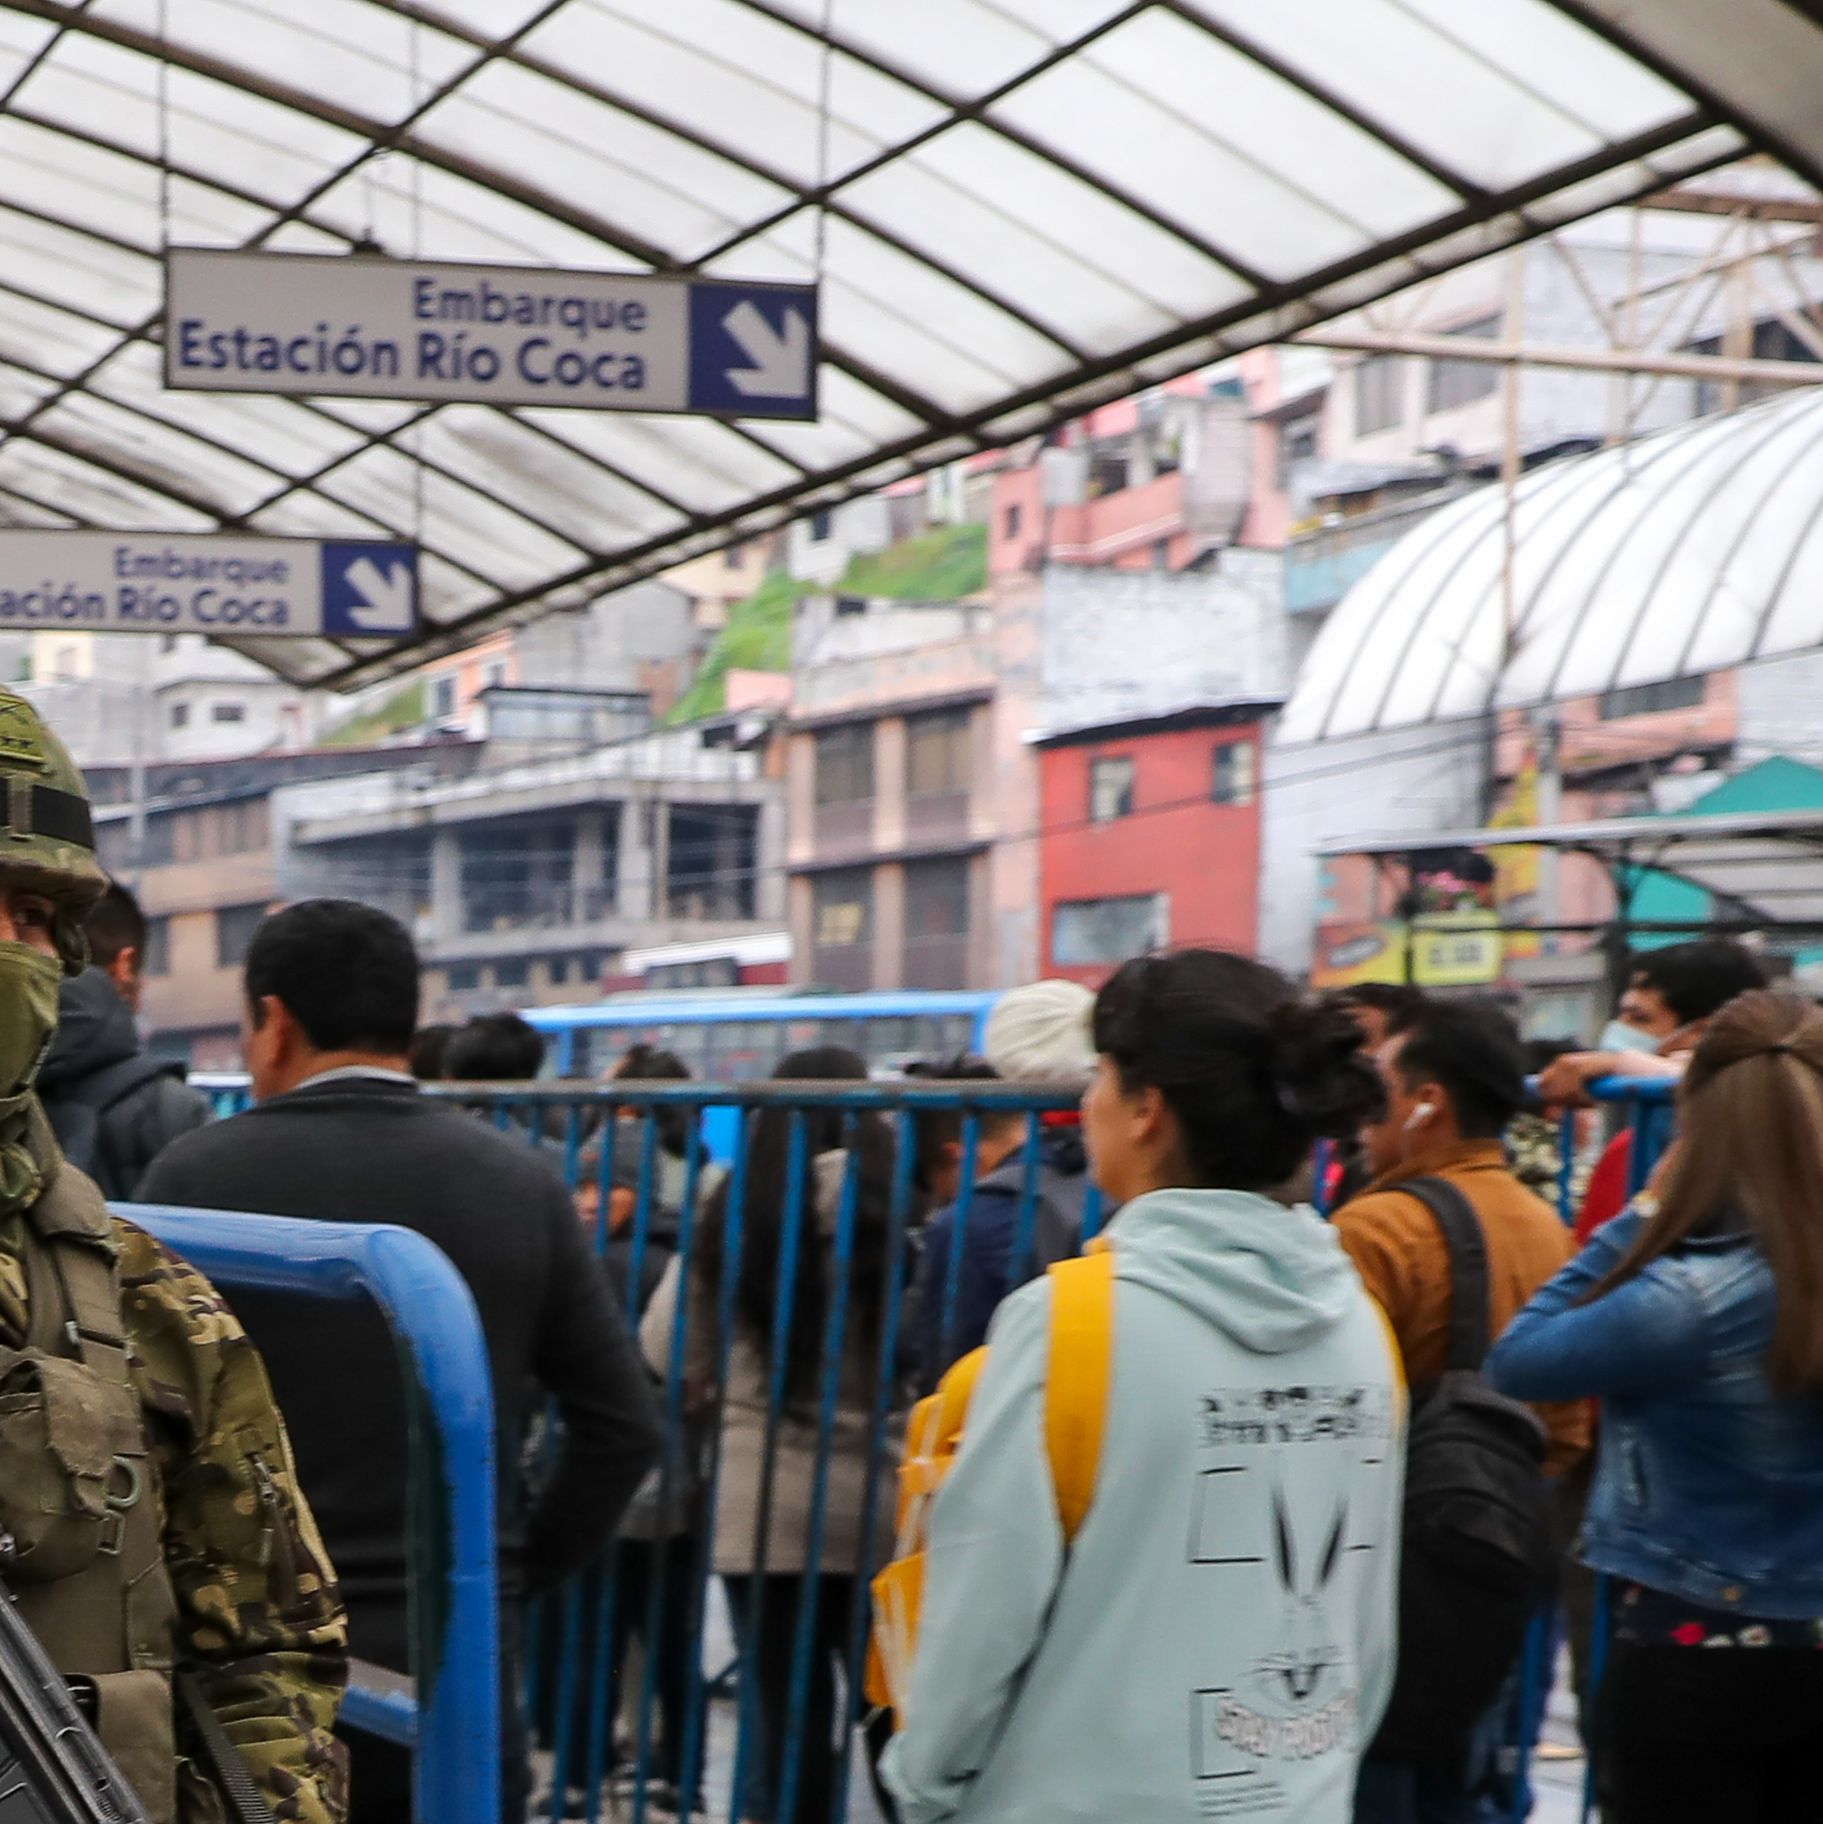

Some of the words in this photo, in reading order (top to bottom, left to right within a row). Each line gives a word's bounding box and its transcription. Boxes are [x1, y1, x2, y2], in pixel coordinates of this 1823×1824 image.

[411, 276, 647, 342] Embarque
[178, 318, 400, 377] Estación
[417, 330, 501, 384] Río
[516, 337, 647, 391] Coca
[113, 546, 290, 588] Embarque
[117, 584, 181, 623] Río
[190, 588, 290, 626] Coca
